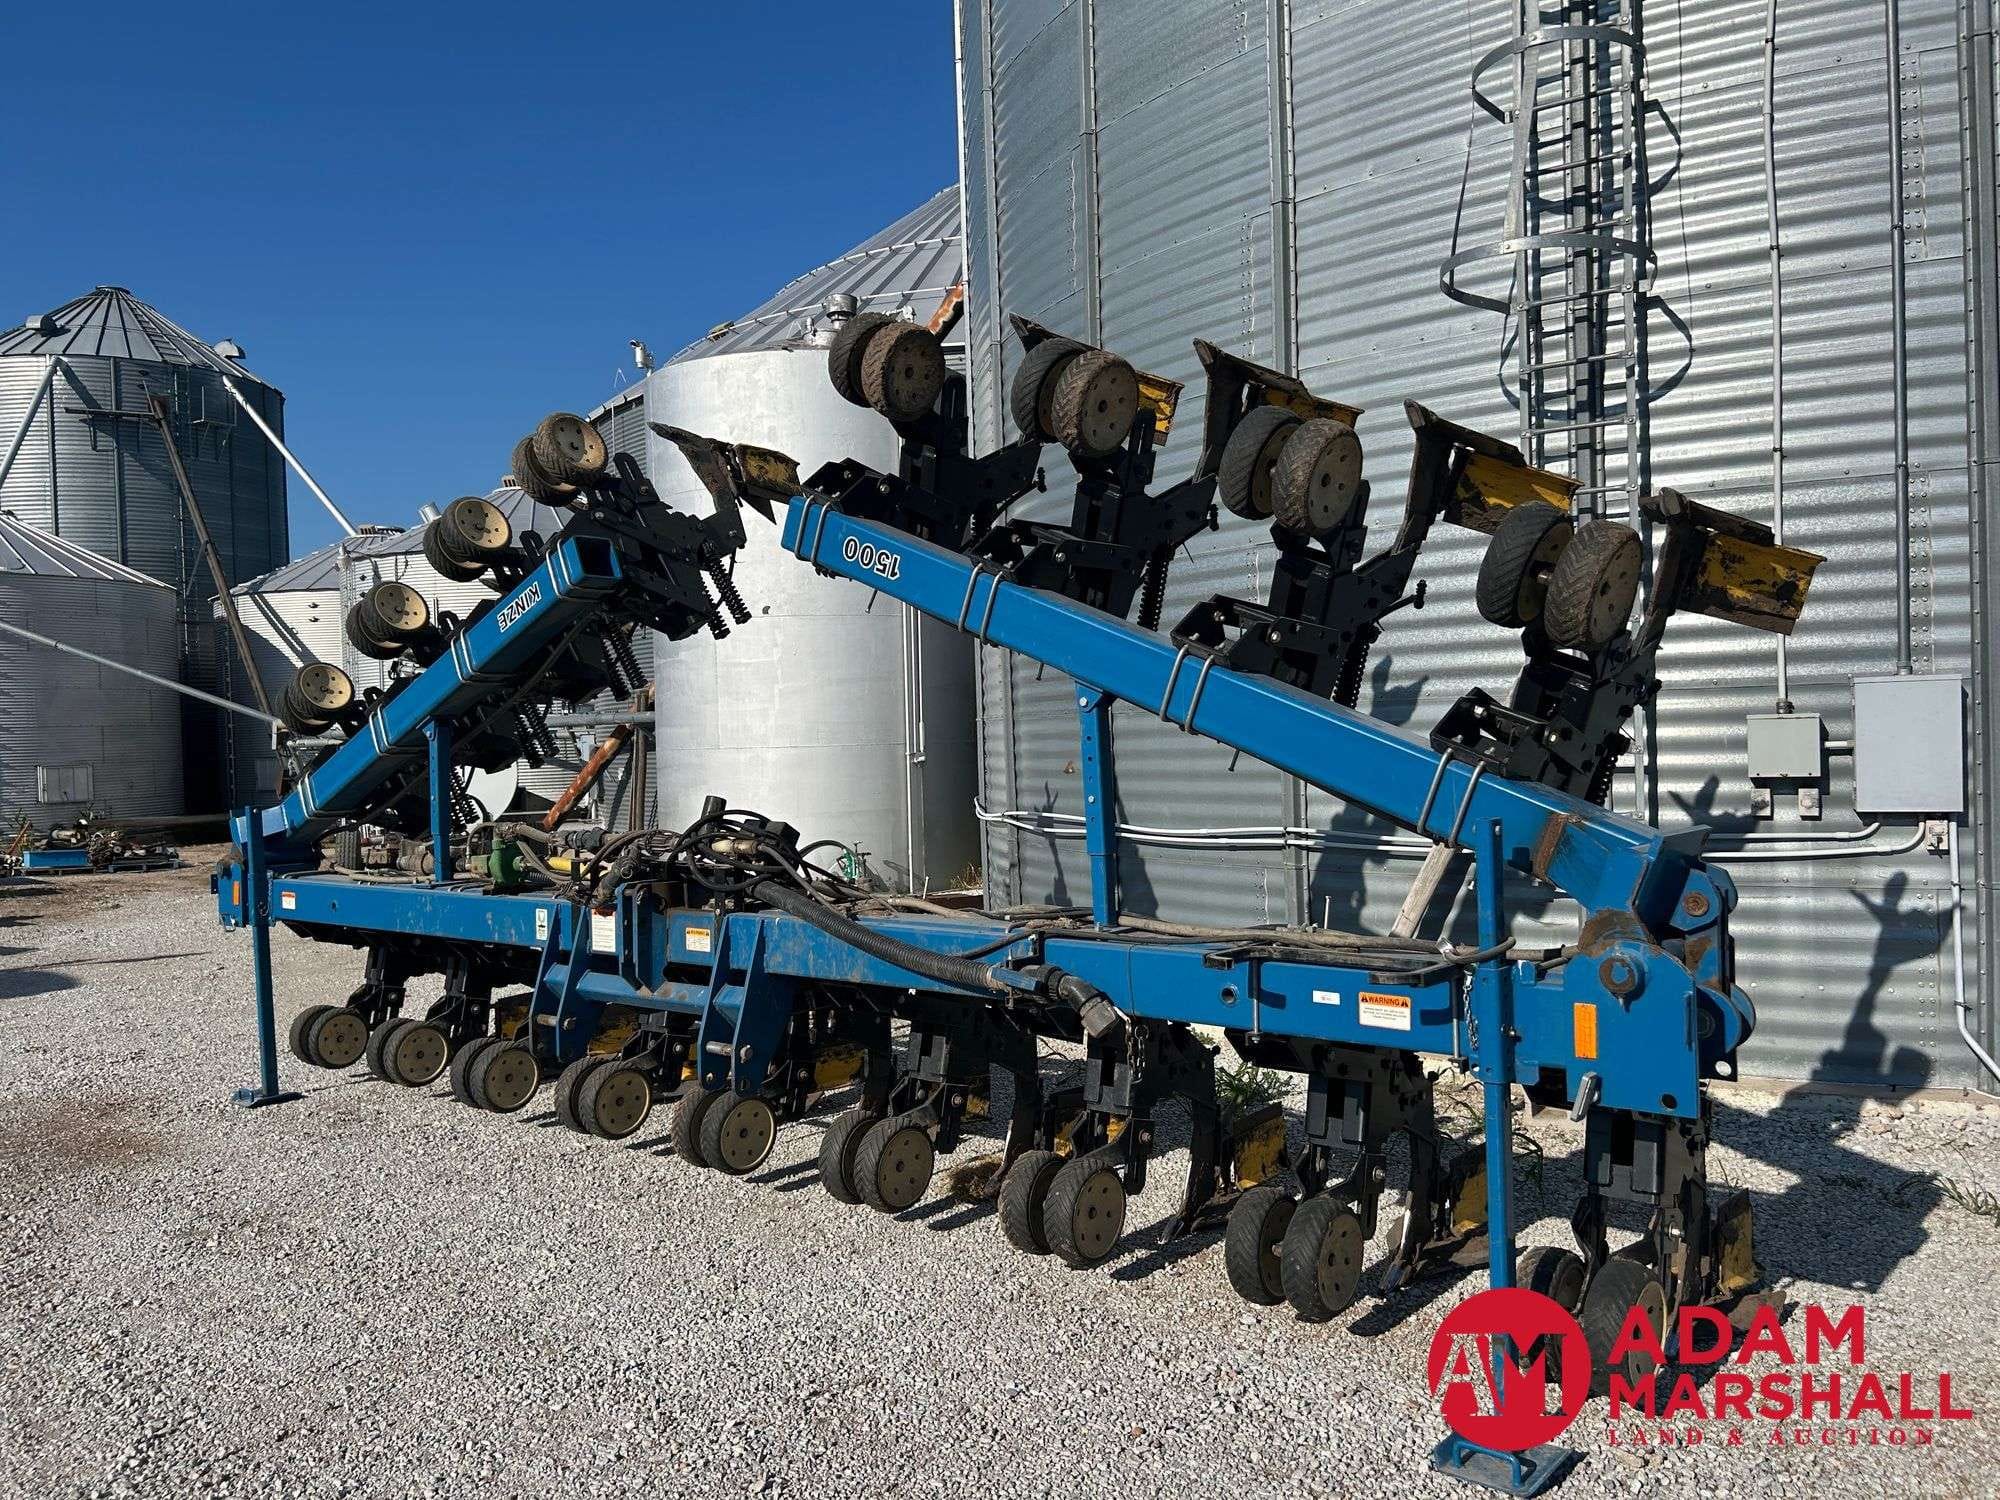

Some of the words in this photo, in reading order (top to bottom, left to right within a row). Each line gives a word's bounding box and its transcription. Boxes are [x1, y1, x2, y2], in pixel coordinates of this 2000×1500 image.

[843, 536, 900, 580] 1500
[497, 581, 541, 632] KINZE
[1368, 995, 1400, 1006] WARNING
